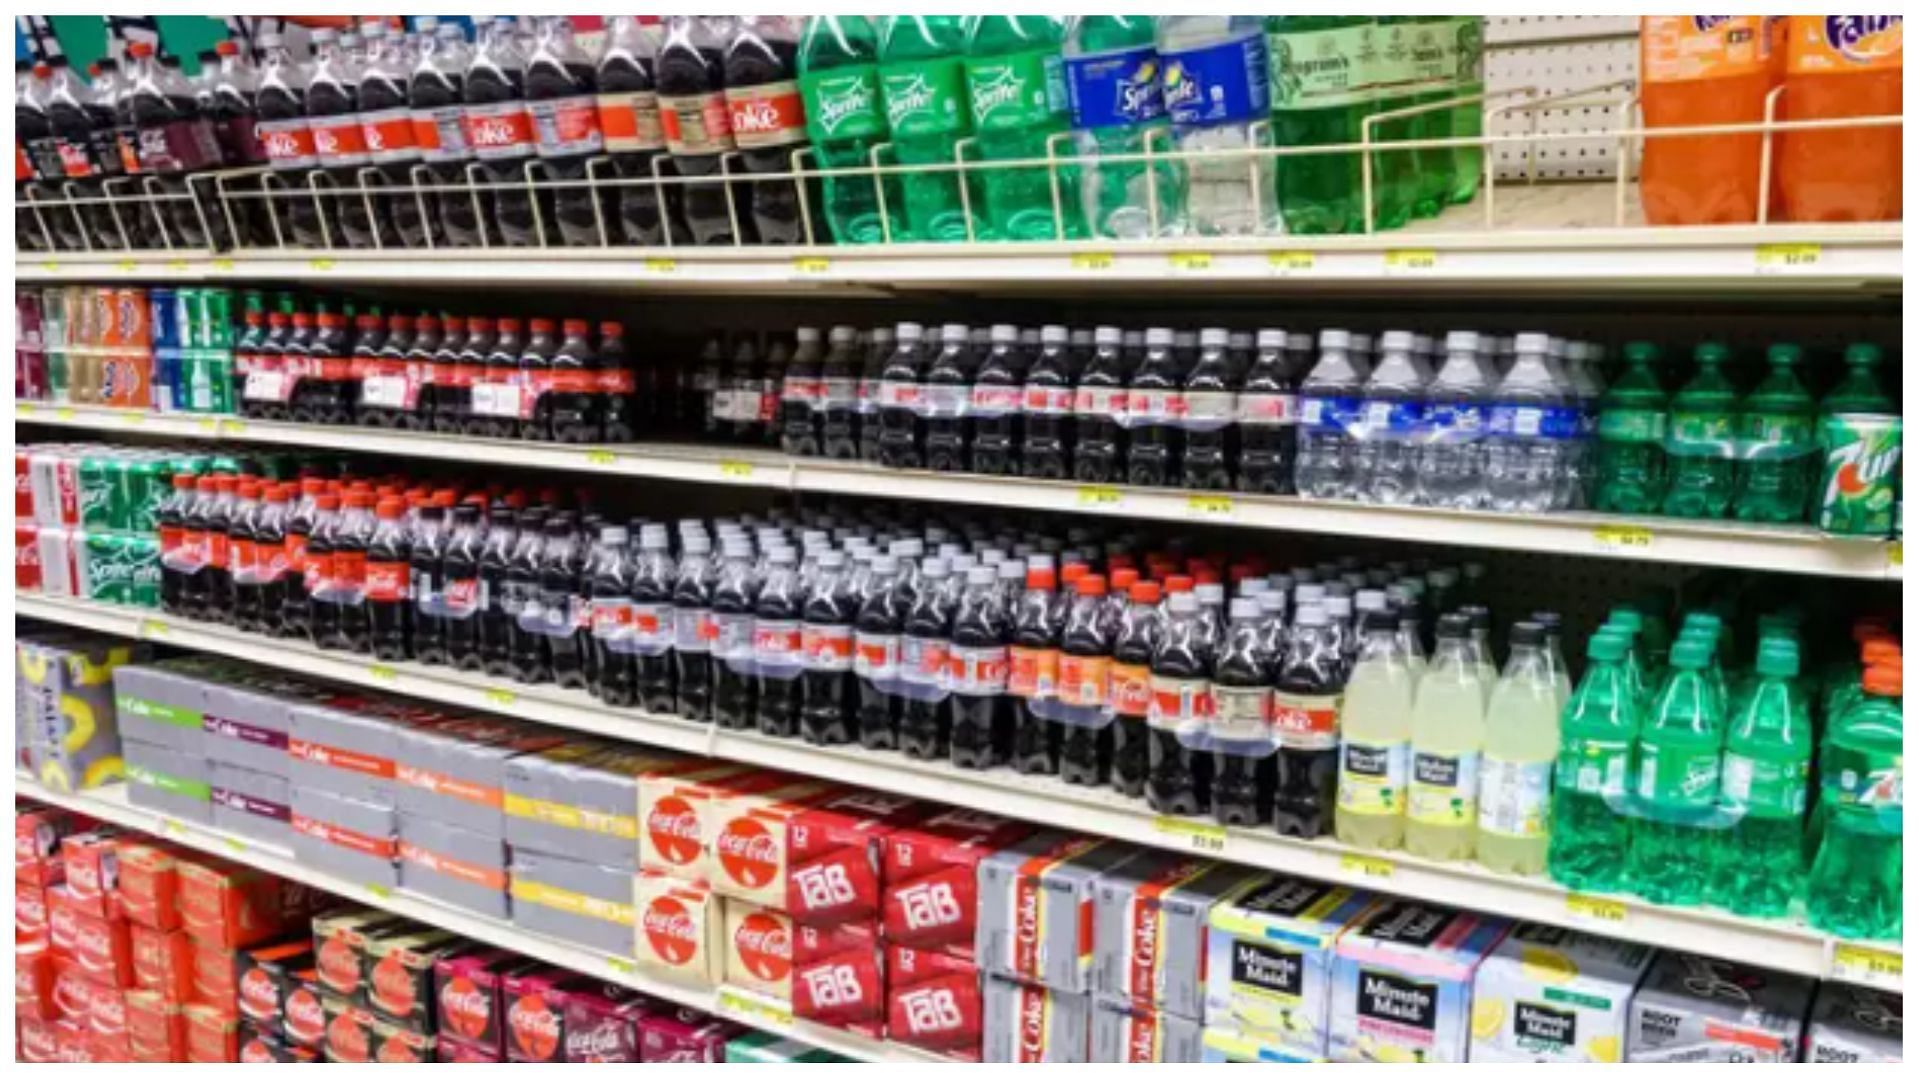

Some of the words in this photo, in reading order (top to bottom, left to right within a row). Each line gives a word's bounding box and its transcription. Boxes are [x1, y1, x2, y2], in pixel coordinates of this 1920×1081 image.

[1238, 946, 1297, 973] Minute
[1246, 962, 1291, 986] Maid
[1365, 976, 1432, 1007] Minute
[1372, 995, 1423, 1021] Maid
[1519, 1007, 1573, 1030] Minute
[1641, 1009, 1682, 1027] ROOT
[1525, 1020, 1565, 1039] Maid
[1133, 1027, 1153, 1064] oke
